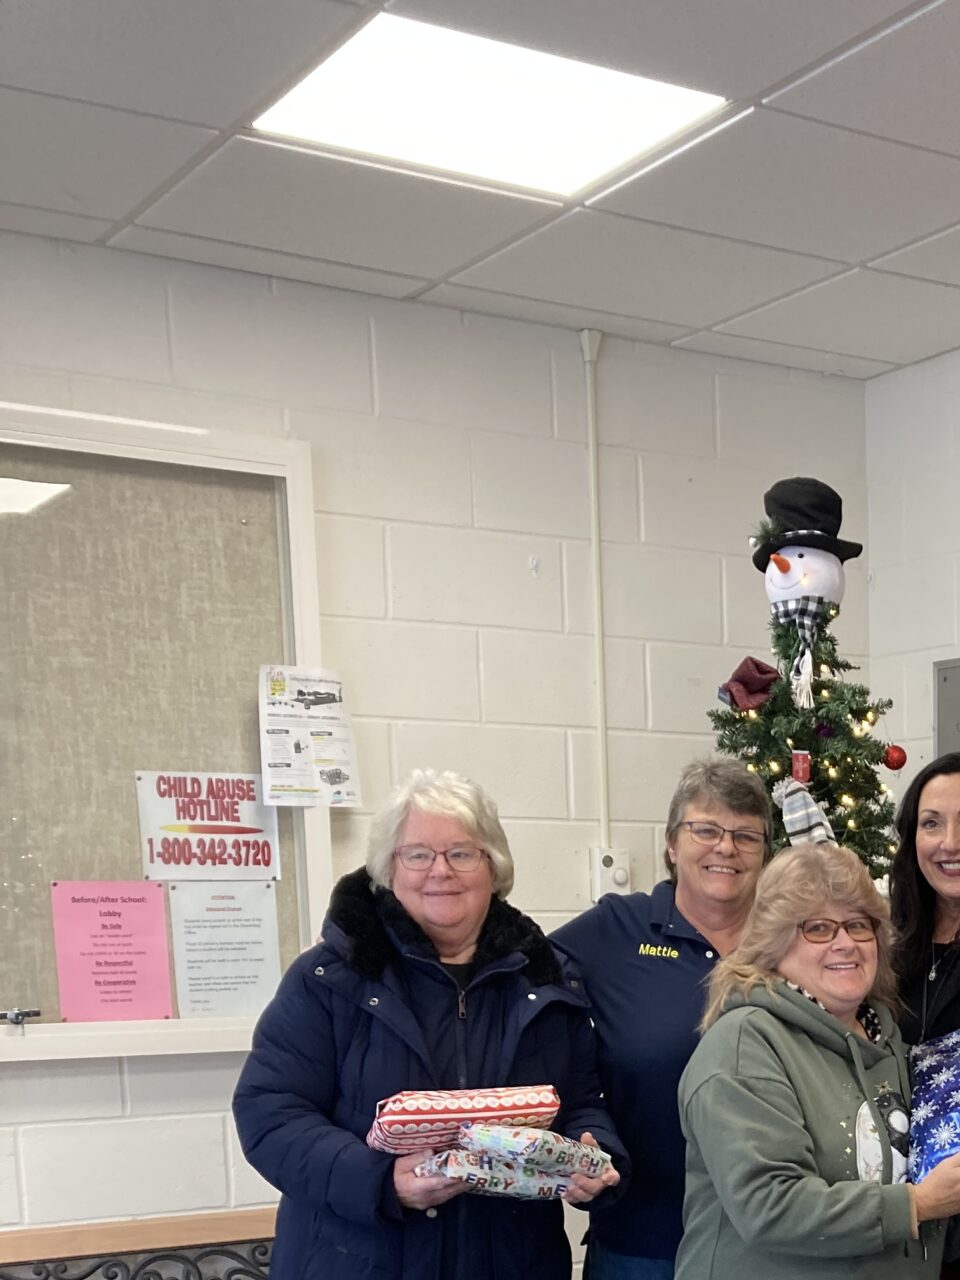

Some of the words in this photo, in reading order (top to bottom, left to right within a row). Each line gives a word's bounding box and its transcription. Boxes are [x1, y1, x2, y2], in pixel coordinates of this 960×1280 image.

[156, 775, 202, 799] CHILD
[206, 778, 256, 801] ABUSE
[175, 798, 240, 822] HOTLINE
[147, 837, 271, 867] 1-800-342-3720
[638, 943, 679, 958] Mattie
